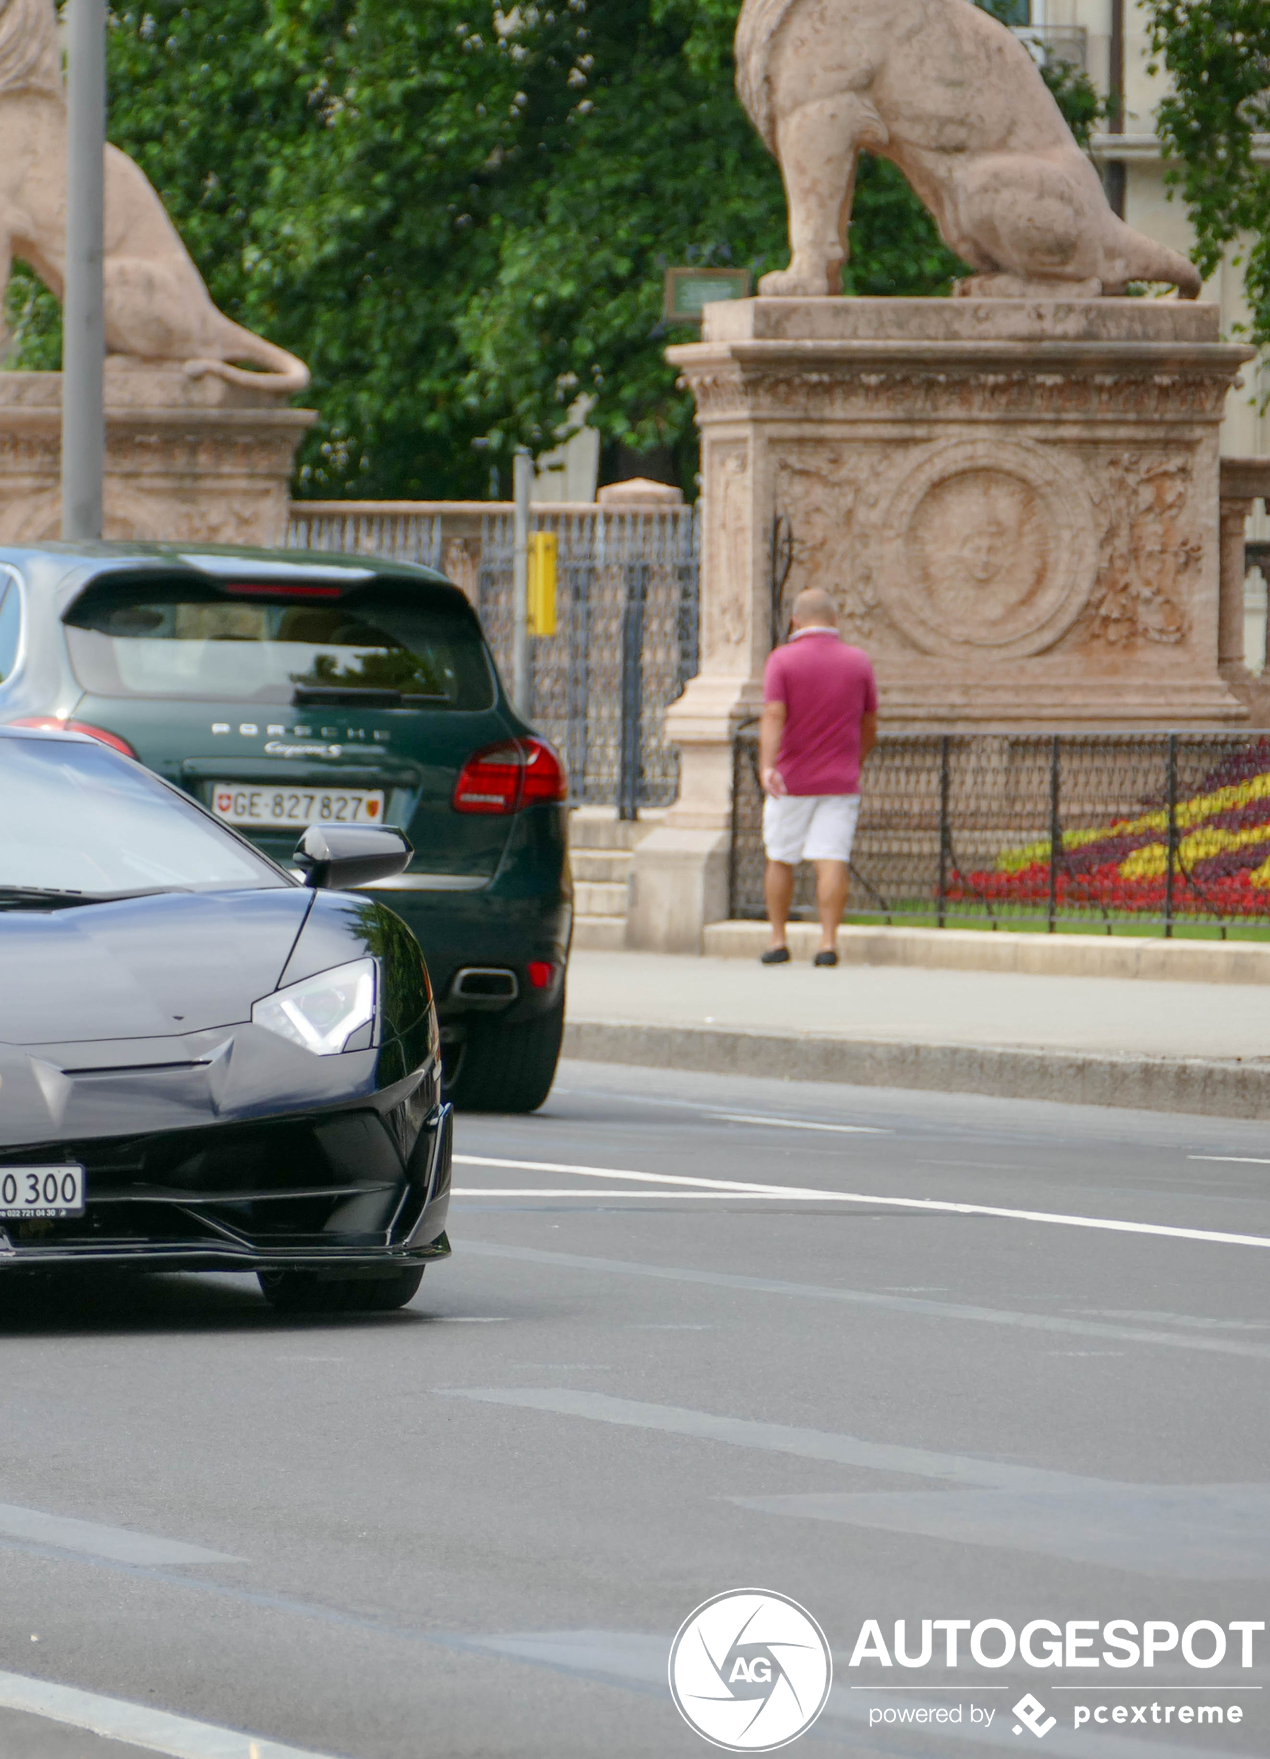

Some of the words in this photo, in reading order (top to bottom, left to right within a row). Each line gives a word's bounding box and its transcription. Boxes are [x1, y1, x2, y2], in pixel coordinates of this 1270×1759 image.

[211, 723, 391, 740] PORSCHE
[319, 796, 364, 822] 827
[24, 1173, 77, 1204] 300
[7, 1209, 21, 1217] 022
[22, 1209, 34, 1217] 721
[36, 1209, 45, 1217] 04
[46, 1208, 56, 1217] 30
